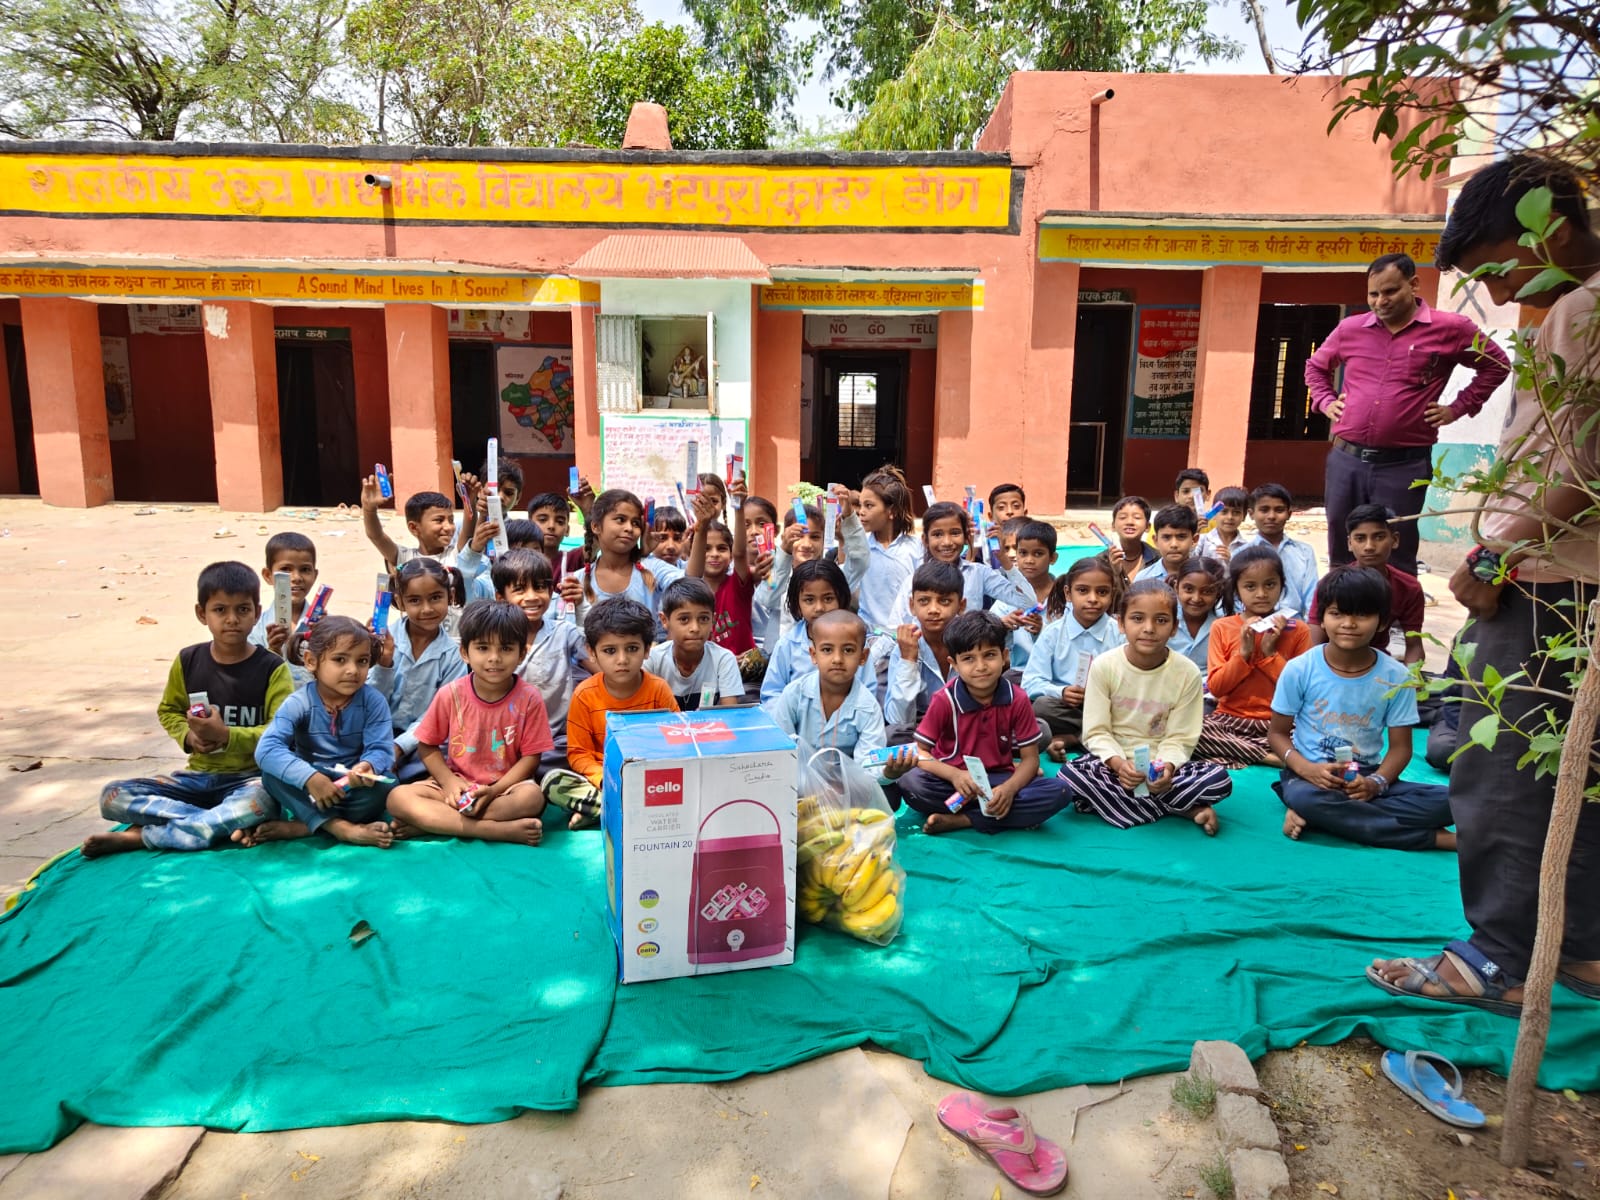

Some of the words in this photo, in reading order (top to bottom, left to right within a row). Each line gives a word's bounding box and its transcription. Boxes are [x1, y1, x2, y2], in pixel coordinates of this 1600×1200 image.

[203, 168, 294, 208] उच्च
[475, 163, 630, 210] विद्यालय
[1067, 234, 1101, 253] शिक्षा
[1103, 238, 1140, 251] समाज
[1143, 235, 1161, 252] की
[1163, 238, 1198, 253] आत्मा
[1238, 240, 1259, 256] एक
[1316, 236, 1353, 259] दूसरी
[1411, 238, 1426, 260] दी
[114, 277, 145, 291] लक्ष्य
[173, 278, 206, 290] प्राप्त
[297, 275, 307, 293] A
[309, 276, 348, 294] Sound
[354, 277, 384, 294] Mind
[392, 277, 425, 296] Lives
[432, 280, 443, 296] In
[450, 279, 459, 296] A
[464, 279, 509, 297] Sound
[925, 286, 947, 303] और
[830, 323, 847, 334] NO
[868, 324, 885, 334] GO
[910, 323, 935, 334] TELL
[647, 782, 681, 794] cello
[650, 817, 678, 825] WATER
[646, 824, 681, 832] CARRIER
[633, 841, 680, 852] FOUNTAIN
[682, 840, 693, 849] 20
